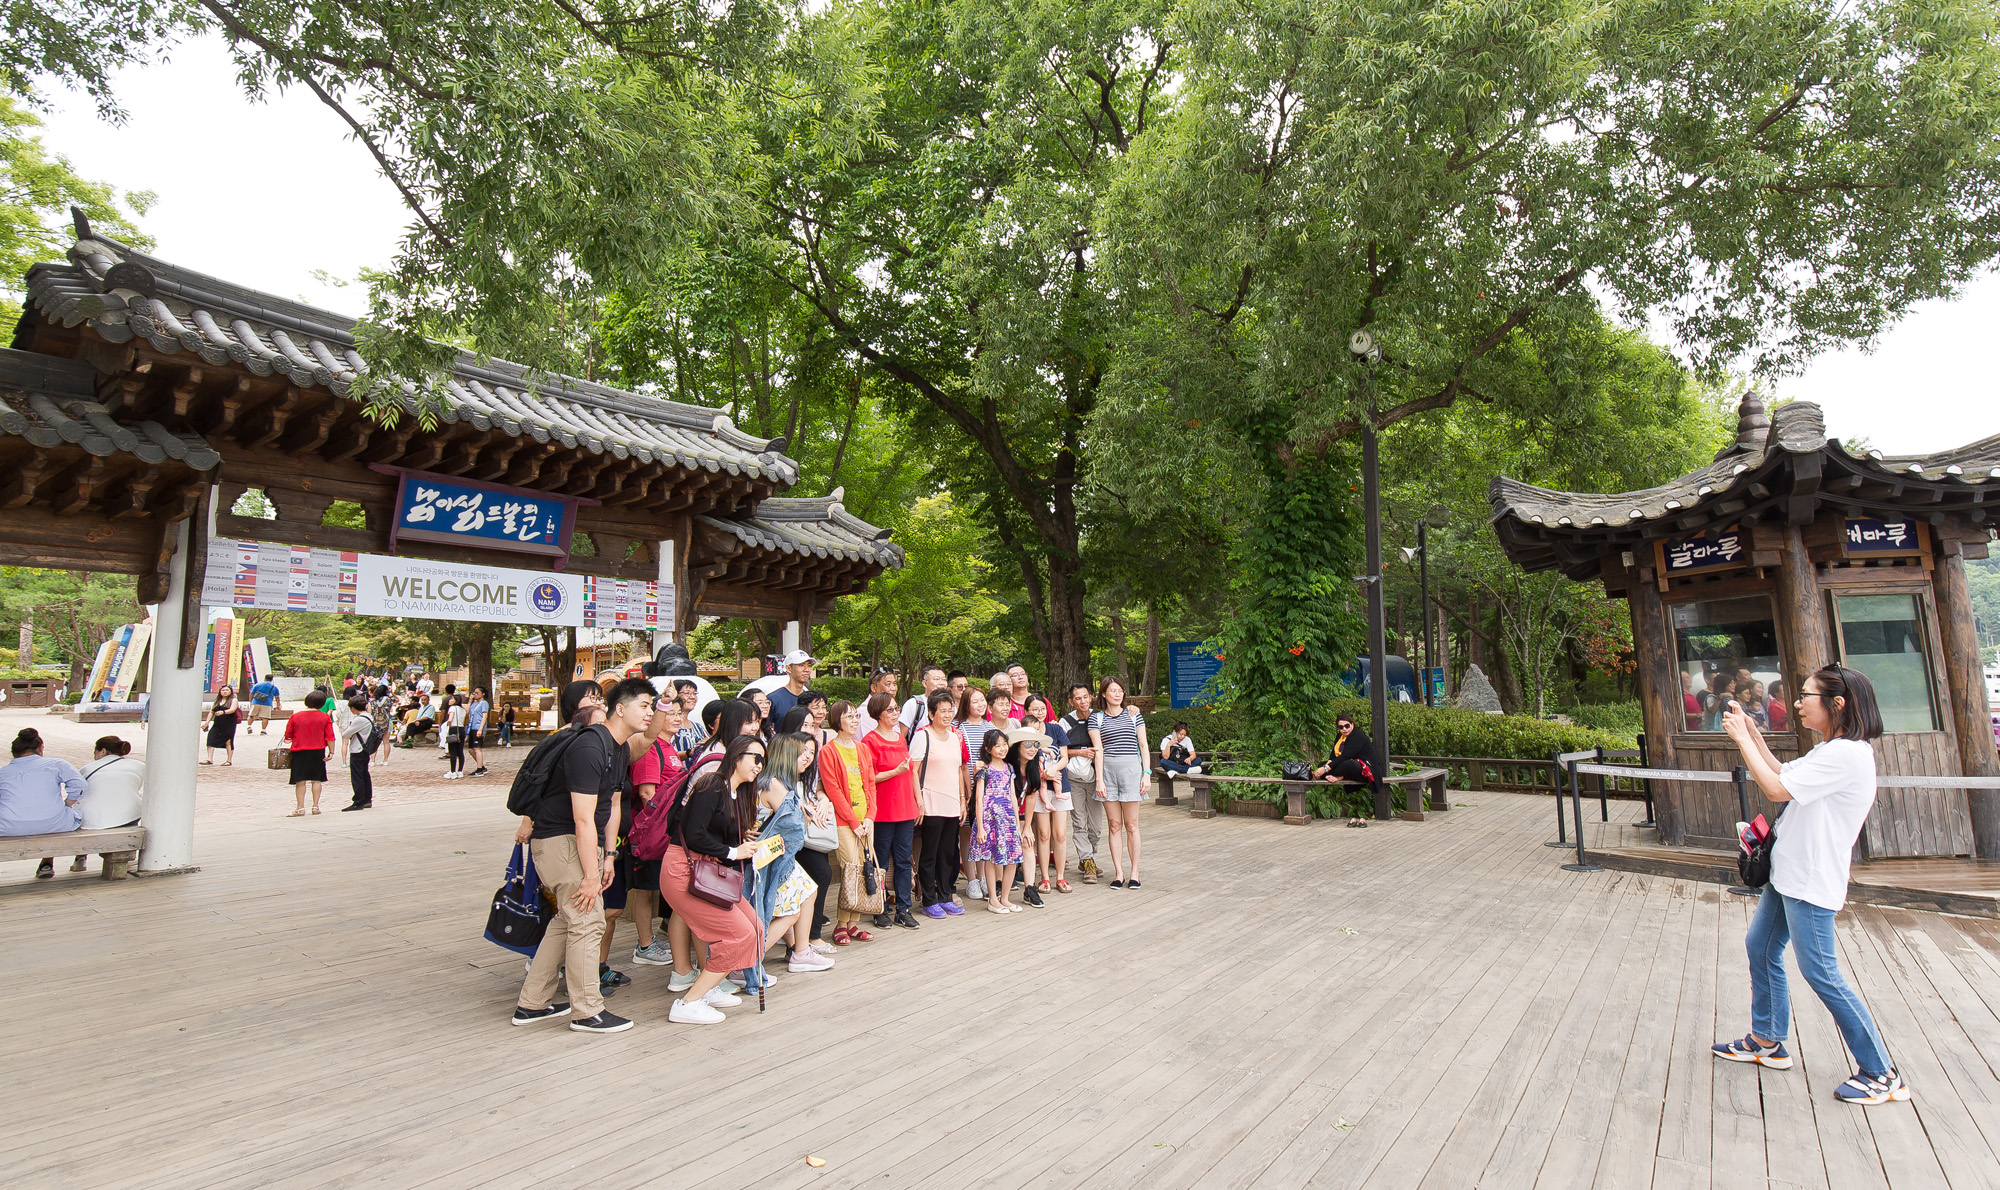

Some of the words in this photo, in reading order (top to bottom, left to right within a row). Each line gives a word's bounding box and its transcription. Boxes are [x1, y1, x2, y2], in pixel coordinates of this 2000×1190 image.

[406, 486, 485, 532] 남이섬
[406, 566, 450, 576] 나미나라공화국
[451, 570, 469, 578] 방문을
[470, 572, 498, 580] 환영합니다
[382, 575, 518, 605] WELCOME
[383, 599, 398, 609] TO
[401, 600, 466, 614] NAMINARA
[469, 605, 518, 616] REPUBLIC
[216, 632, 228, 682] PANCHATANTRA
